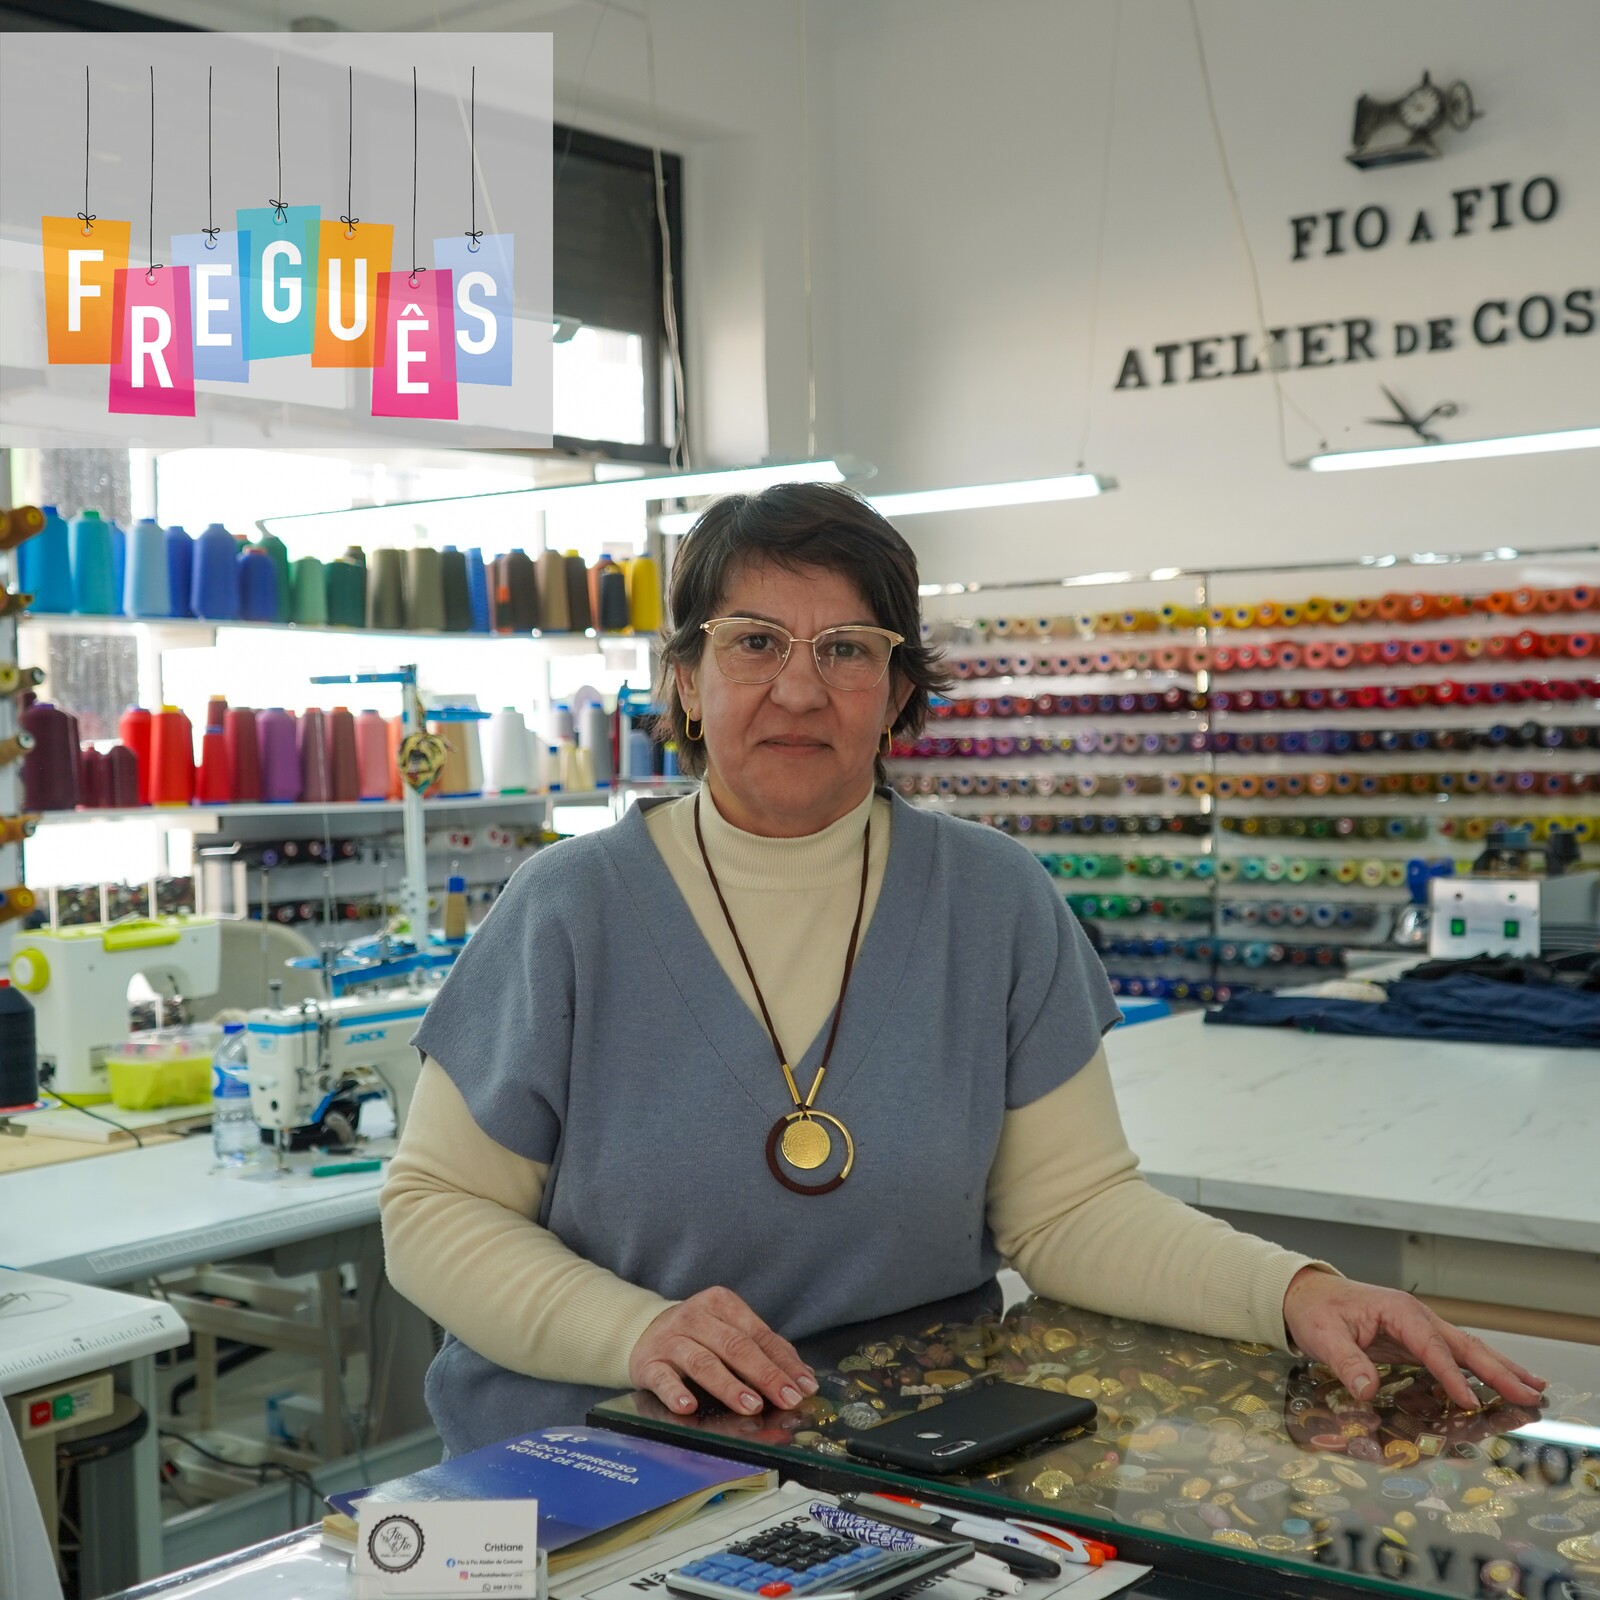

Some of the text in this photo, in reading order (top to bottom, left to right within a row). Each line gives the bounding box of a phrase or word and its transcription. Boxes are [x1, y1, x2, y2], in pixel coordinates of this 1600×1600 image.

[1291, 177, 1558, 261] FIO A FIO
[1395, 319, 1453, 354] DE
[506, 1444, 639, 1485] NOTAS DE ENTREGA
[519, 1439, 637, 1473] BLOCO IMPRESSO
[484, 1543, 524, 1552] Cristiane
